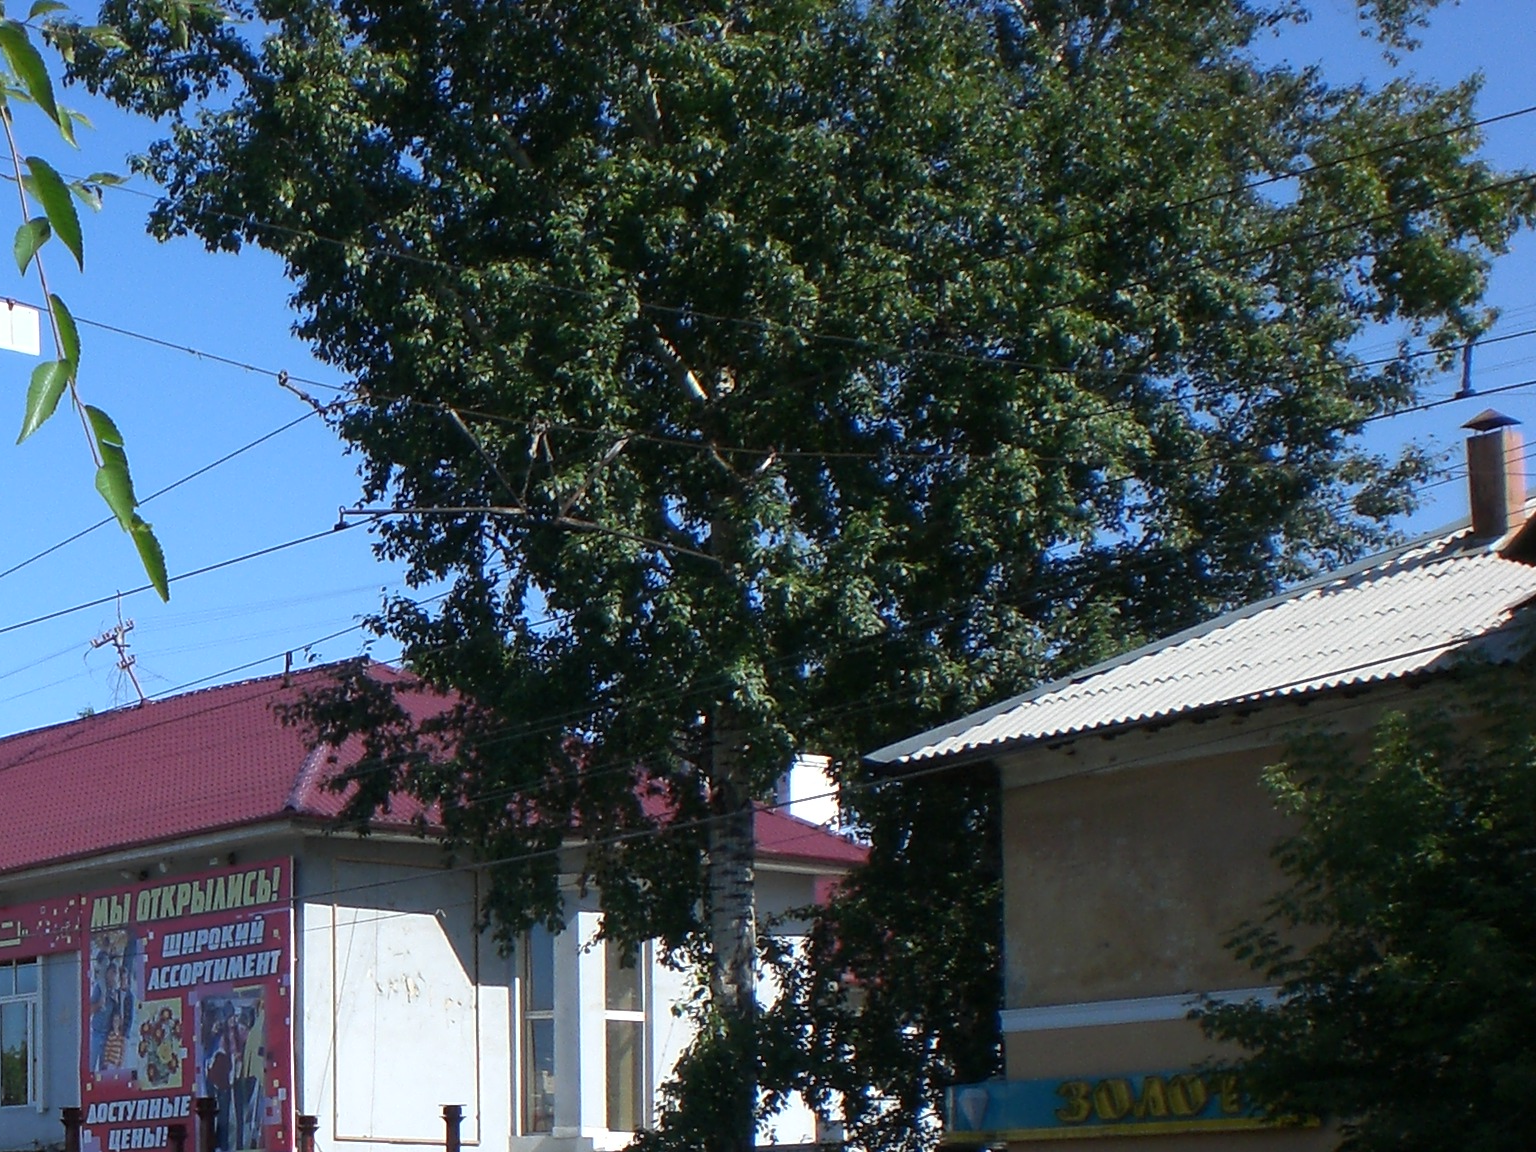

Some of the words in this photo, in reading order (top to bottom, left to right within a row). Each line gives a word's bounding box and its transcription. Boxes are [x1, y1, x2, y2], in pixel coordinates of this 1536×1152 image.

[91, 893, 131, 928] МЫ
[136, 867, 281, 922] ОТКРЫЛИСЬ!
[162, 914, 264, 958] ШИРОКИЙ
[147, 949, 281, 991] АССОРТИМЕНТ
[86, 1095, 191, 1125] ДОСТУПНЫЕ
[109, 1126, 168, 1152] ЦЕНЫ!
